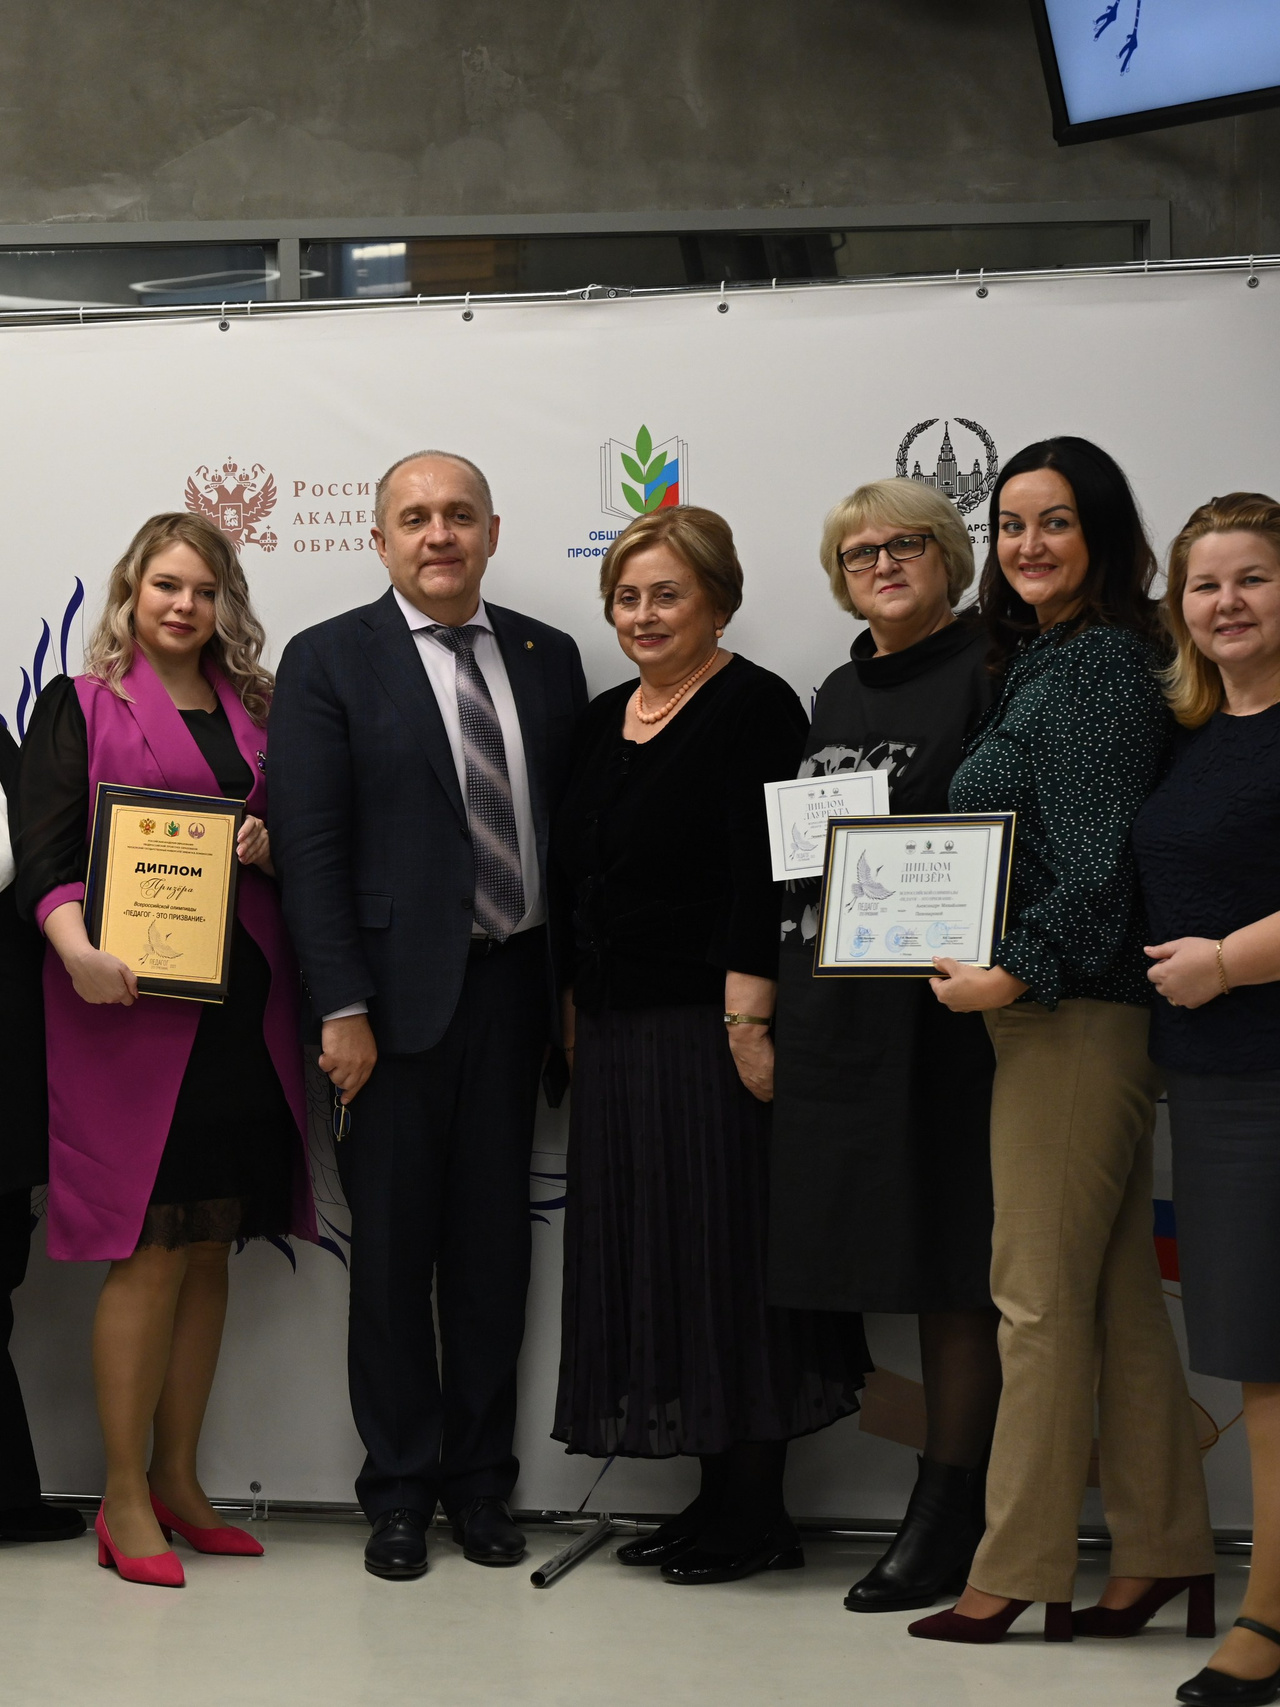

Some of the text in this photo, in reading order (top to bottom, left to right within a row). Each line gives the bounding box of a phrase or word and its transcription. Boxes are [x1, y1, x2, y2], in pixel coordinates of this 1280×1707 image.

[134, 861, 203, 878] ДИПЛОМ
[901, 862, 951, 872] ДИПЛОМ
[140, 877, 194, 901] Призёра
